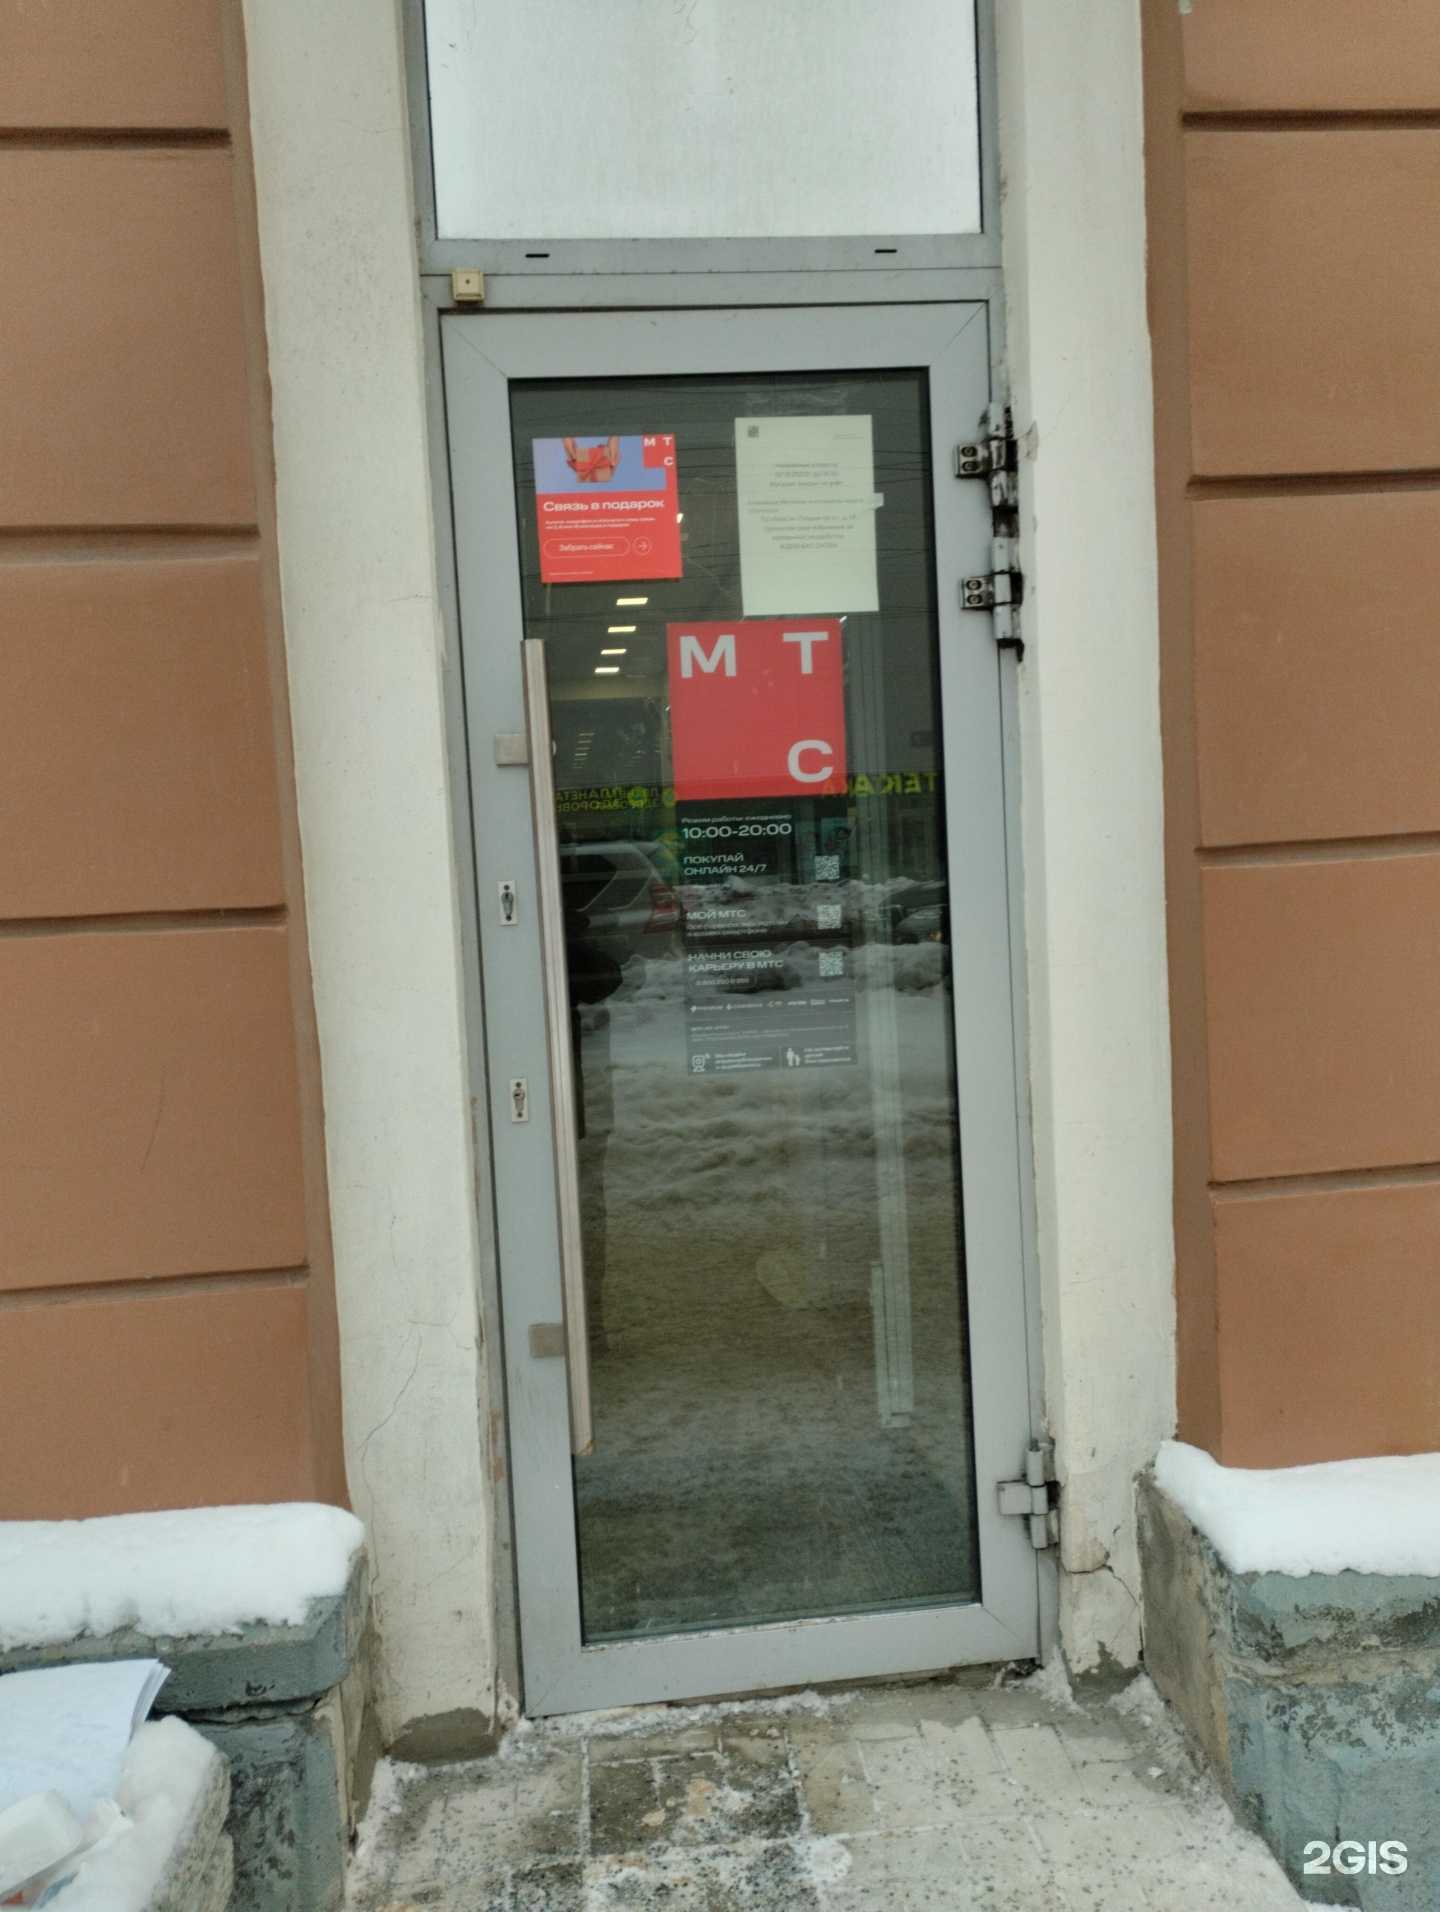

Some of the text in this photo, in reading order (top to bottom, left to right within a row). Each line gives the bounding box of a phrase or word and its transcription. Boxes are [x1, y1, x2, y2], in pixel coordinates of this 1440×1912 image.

[543, 499, 665, 512] Связь в подарок
[683, 823, 792, 839] 10:00-20:00
[683, 852, 744, 864] ПОКУПАЙ
[684, 864, 767, 876] ОНЛАЙН 24/7
[687, 909, 746, 920] МОЙ МТС
[688, 949, 772, 961] НАЧНИ СВОЮ
[688, 962, 744, 973] КАРЬЕРУ
[757, 960, 784, 969] МТС
